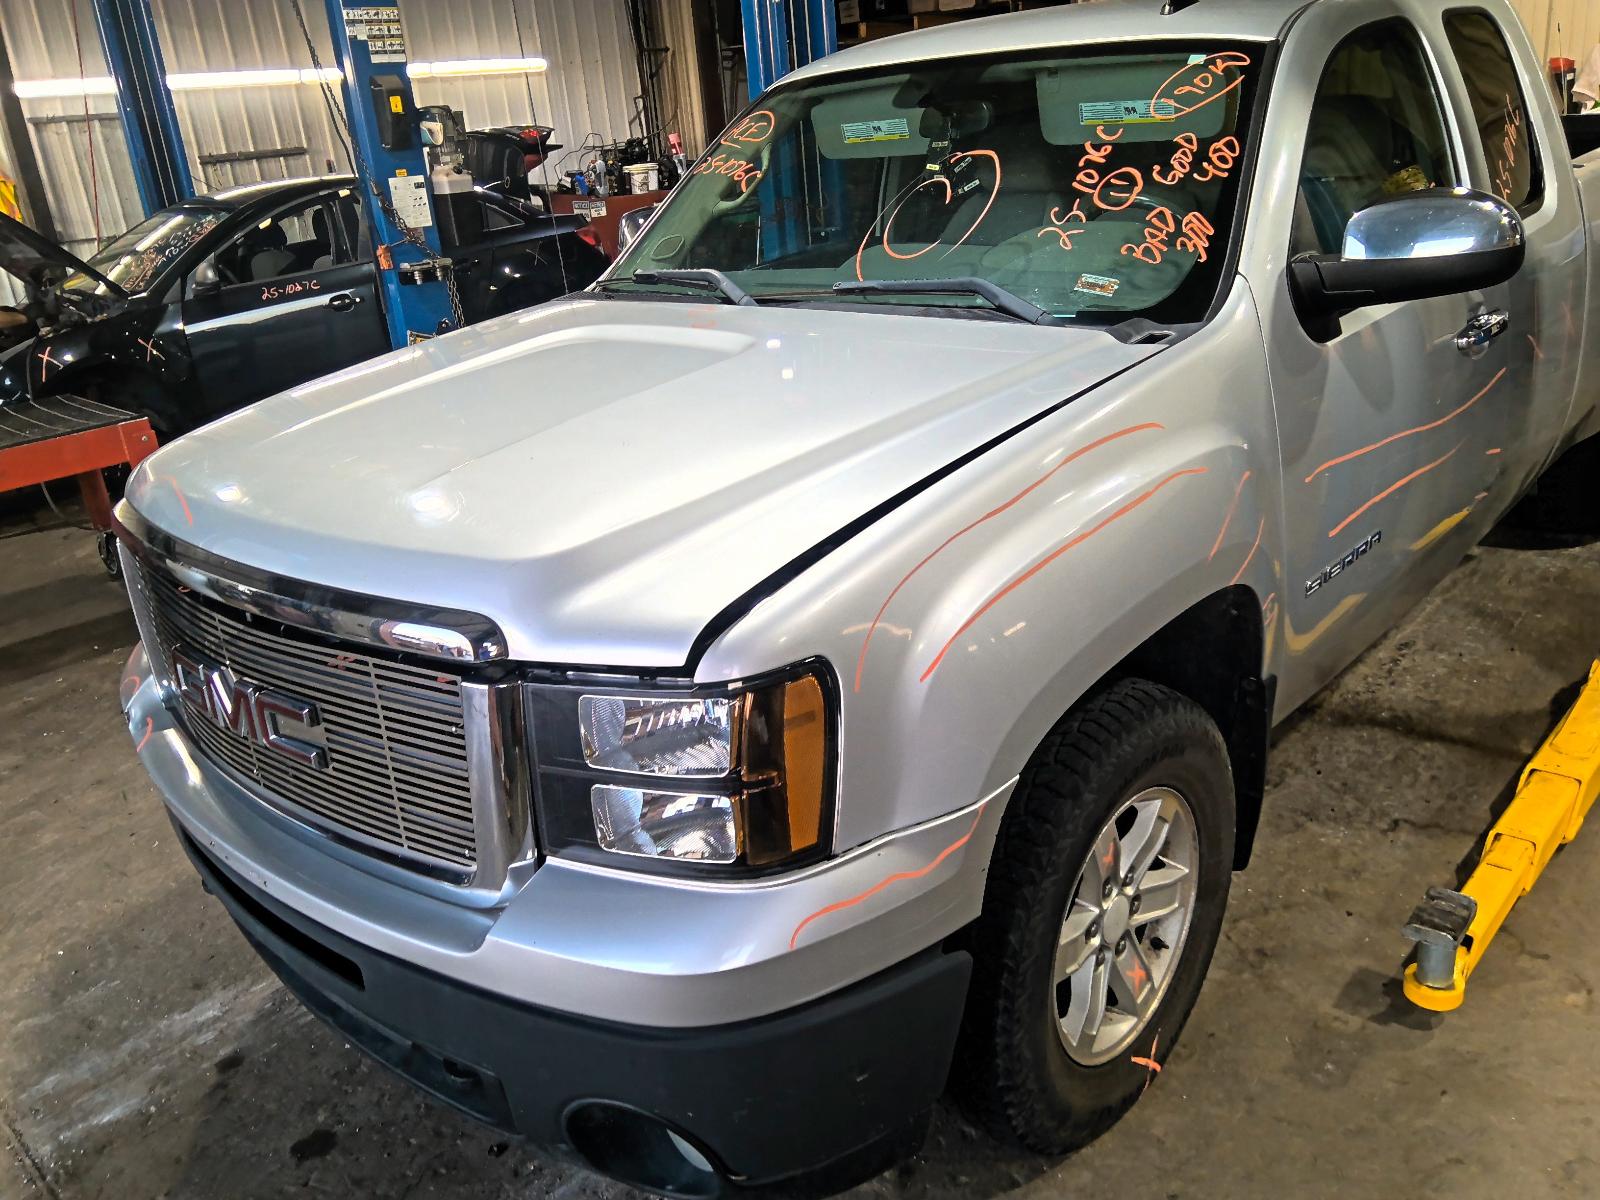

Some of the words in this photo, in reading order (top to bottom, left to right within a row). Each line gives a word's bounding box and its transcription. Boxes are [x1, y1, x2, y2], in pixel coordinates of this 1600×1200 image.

[1153, 132, 1198, 185] GOOD
[1193, 136, 1240, 182] 400
[1120, 207, 1176, 264] BAD
[261, 279, 321, 300] 25-1027C
[1304, 530, 1382, 599] SIERRA
[172, 643, 331, 771] GMC
